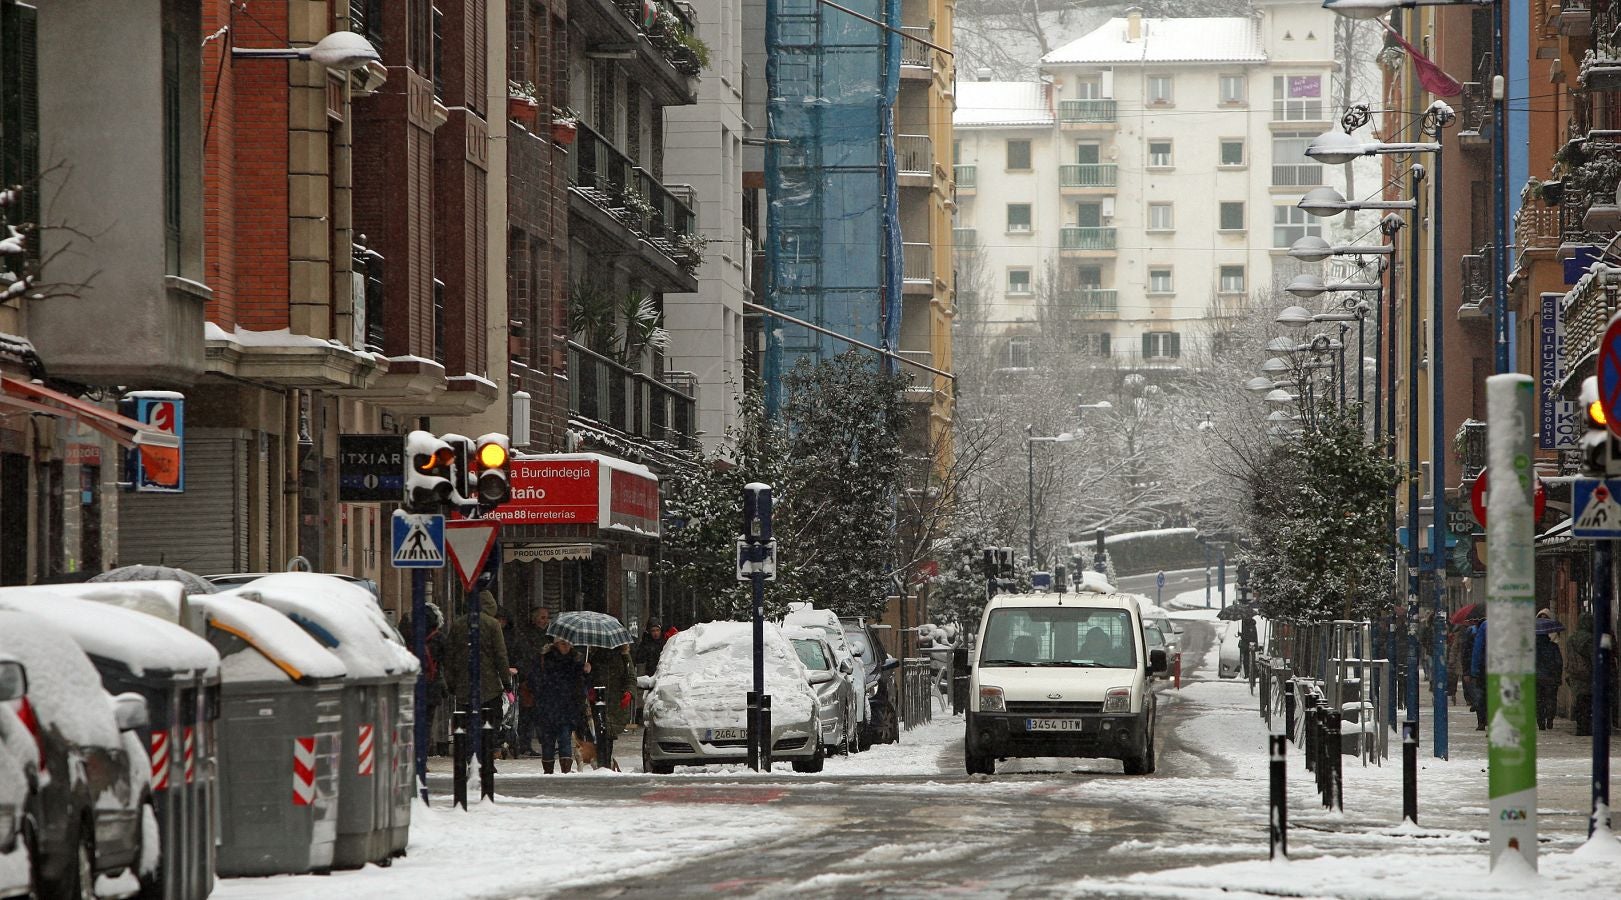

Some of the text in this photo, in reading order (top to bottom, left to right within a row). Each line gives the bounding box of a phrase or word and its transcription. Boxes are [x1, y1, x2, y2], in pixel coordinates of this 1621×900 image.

[1543, 327, 1554, 394] GIPUZKOA
[341, 453, 401, 465] ITXIAR
[521, 466, 591, 480] Burdindegia
[1448, 522, 1474, 533] TOP
[513, 549, 554, 557] PRODUCTOS
[1031, 720, 1081, 730] 3454 DTW
[714, 730, 736, 740] 2464
